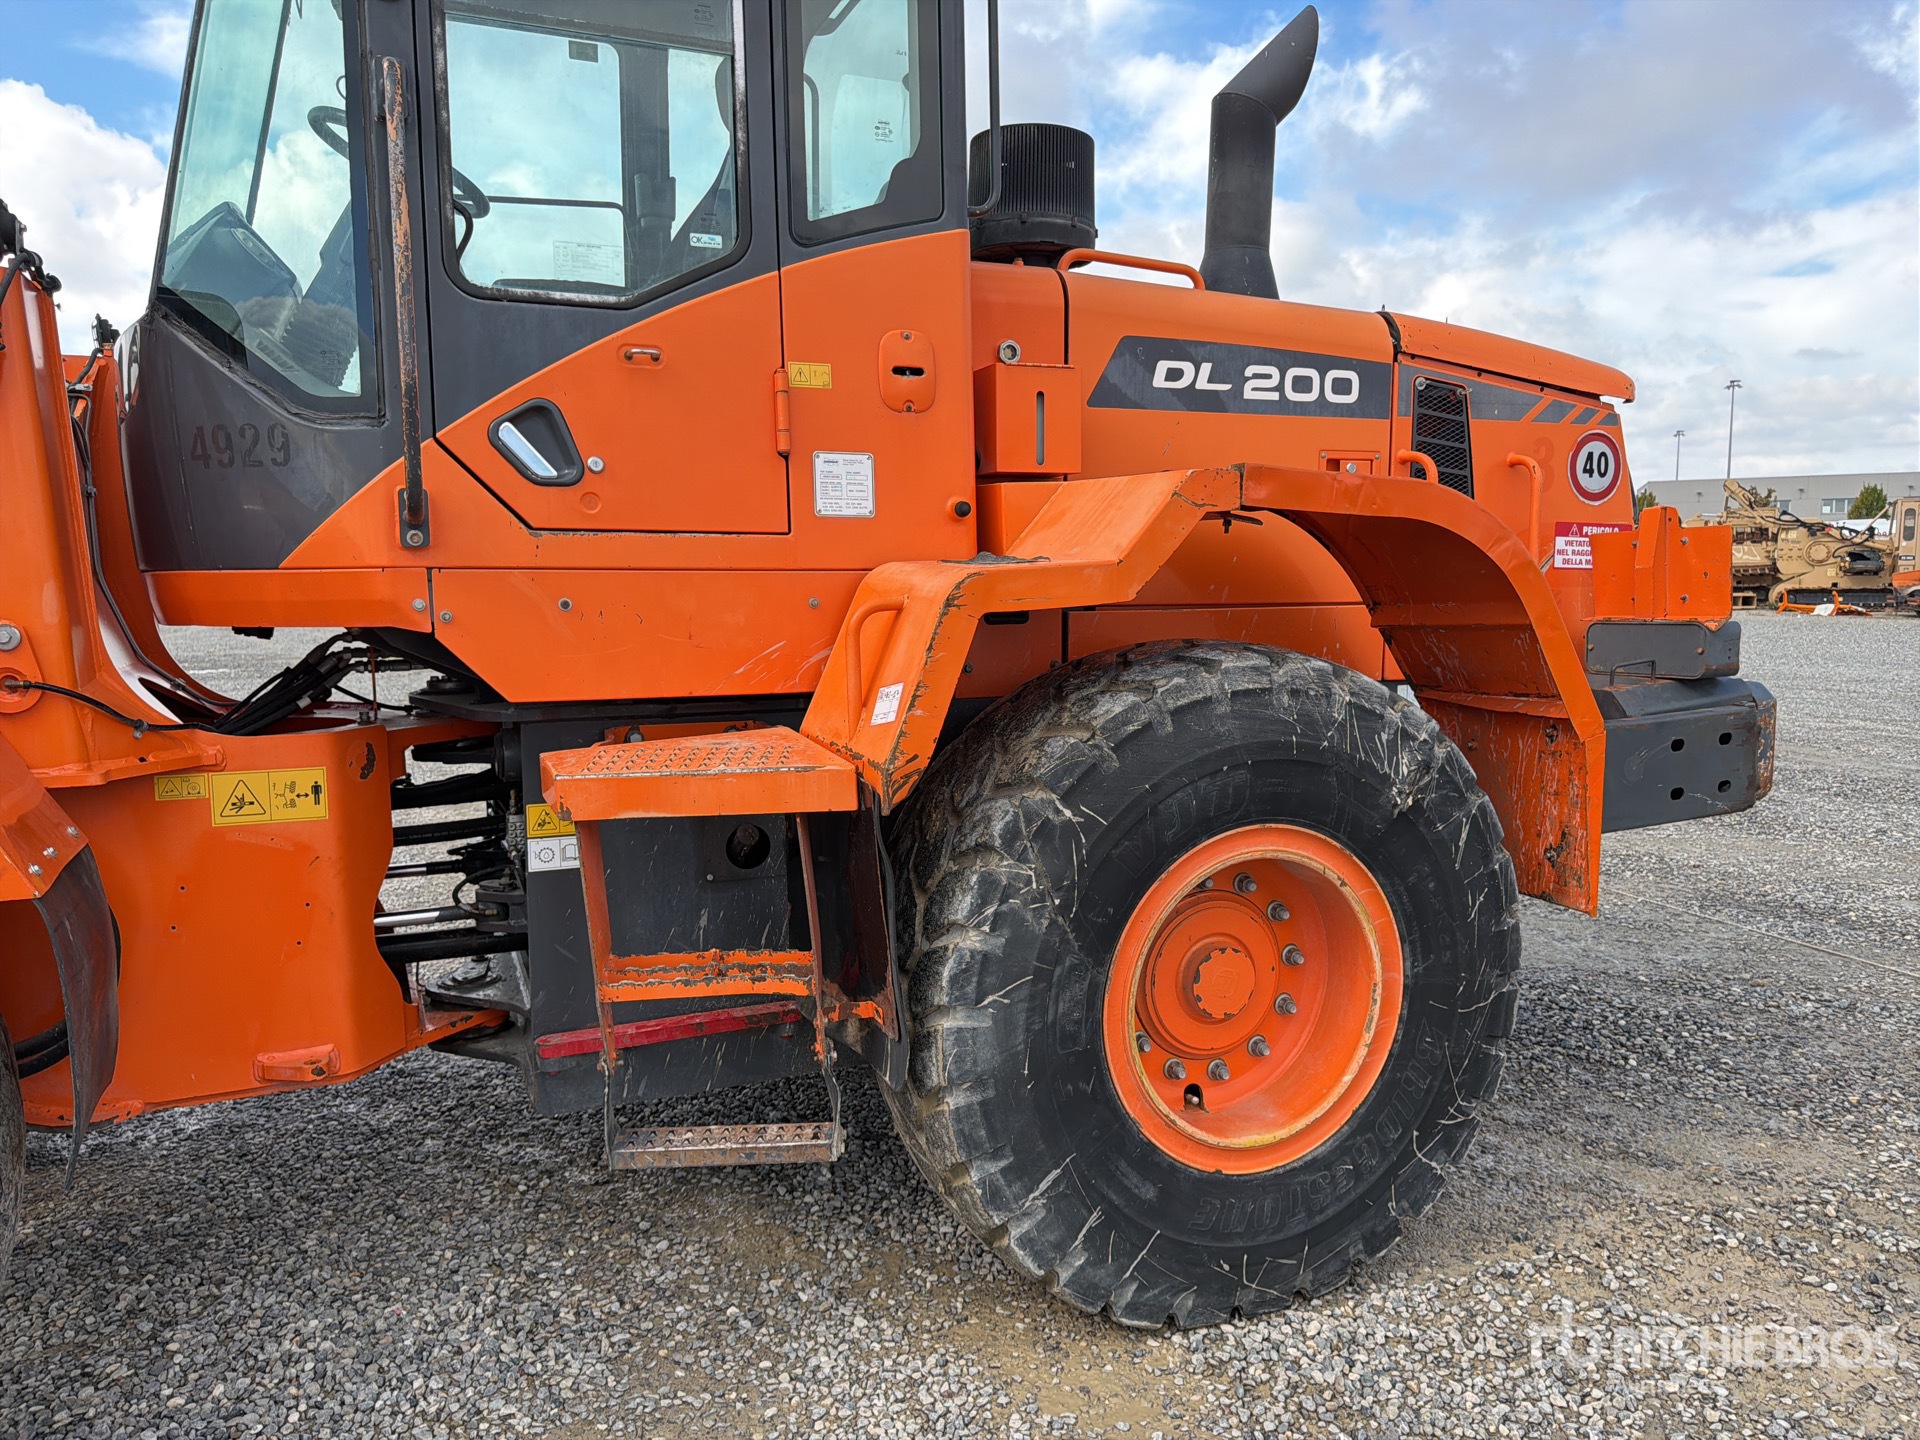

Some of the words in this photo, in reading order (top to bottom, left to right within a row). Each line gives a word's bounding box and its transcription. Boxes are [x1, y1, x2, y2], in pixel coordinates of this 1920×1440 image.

[1152, 360, 1233, 391] DL
[1243, 364, 1360, 404] 200
[191, 423, 291, 469] 4929
[1582, 451, 1609, 478] 40
[1556, 548, 1569, 556] NEL
[1562, 558, 1583, 566] DELLA
[1188, 1017, 1447, 1233] BRIDGESTONE
